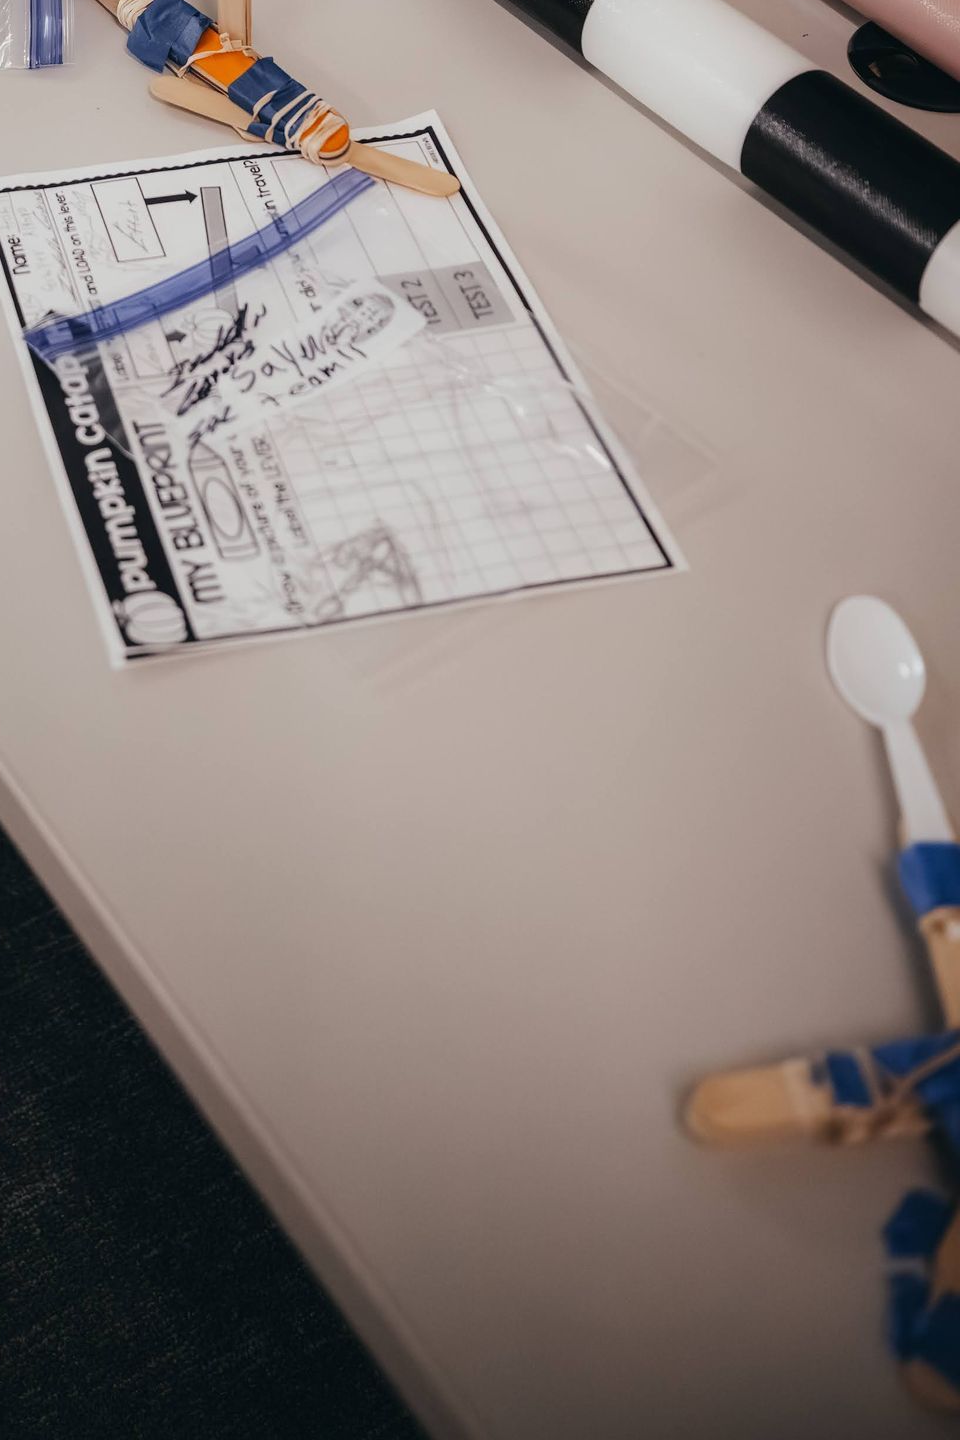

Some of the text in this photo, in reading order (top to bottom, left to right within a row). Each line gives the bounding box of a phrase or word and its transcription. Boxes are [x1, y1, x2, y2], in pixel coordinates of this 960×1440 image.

[243, 159, 271, 200] travel?
[62, 215, 78, 233] this
[7, 233, 32, 276] Name:
[70, 234, 83, 249] on
[72, 249, 91, 277] LOAD
[83, 274, 98, 296] and
[401, 277, 422, 290] 2
[453, 269, 495, 320] TEST 3
[132, 419, 205, 552] BLUEPRINT
[84, 446, 157, 593] pumpkin
